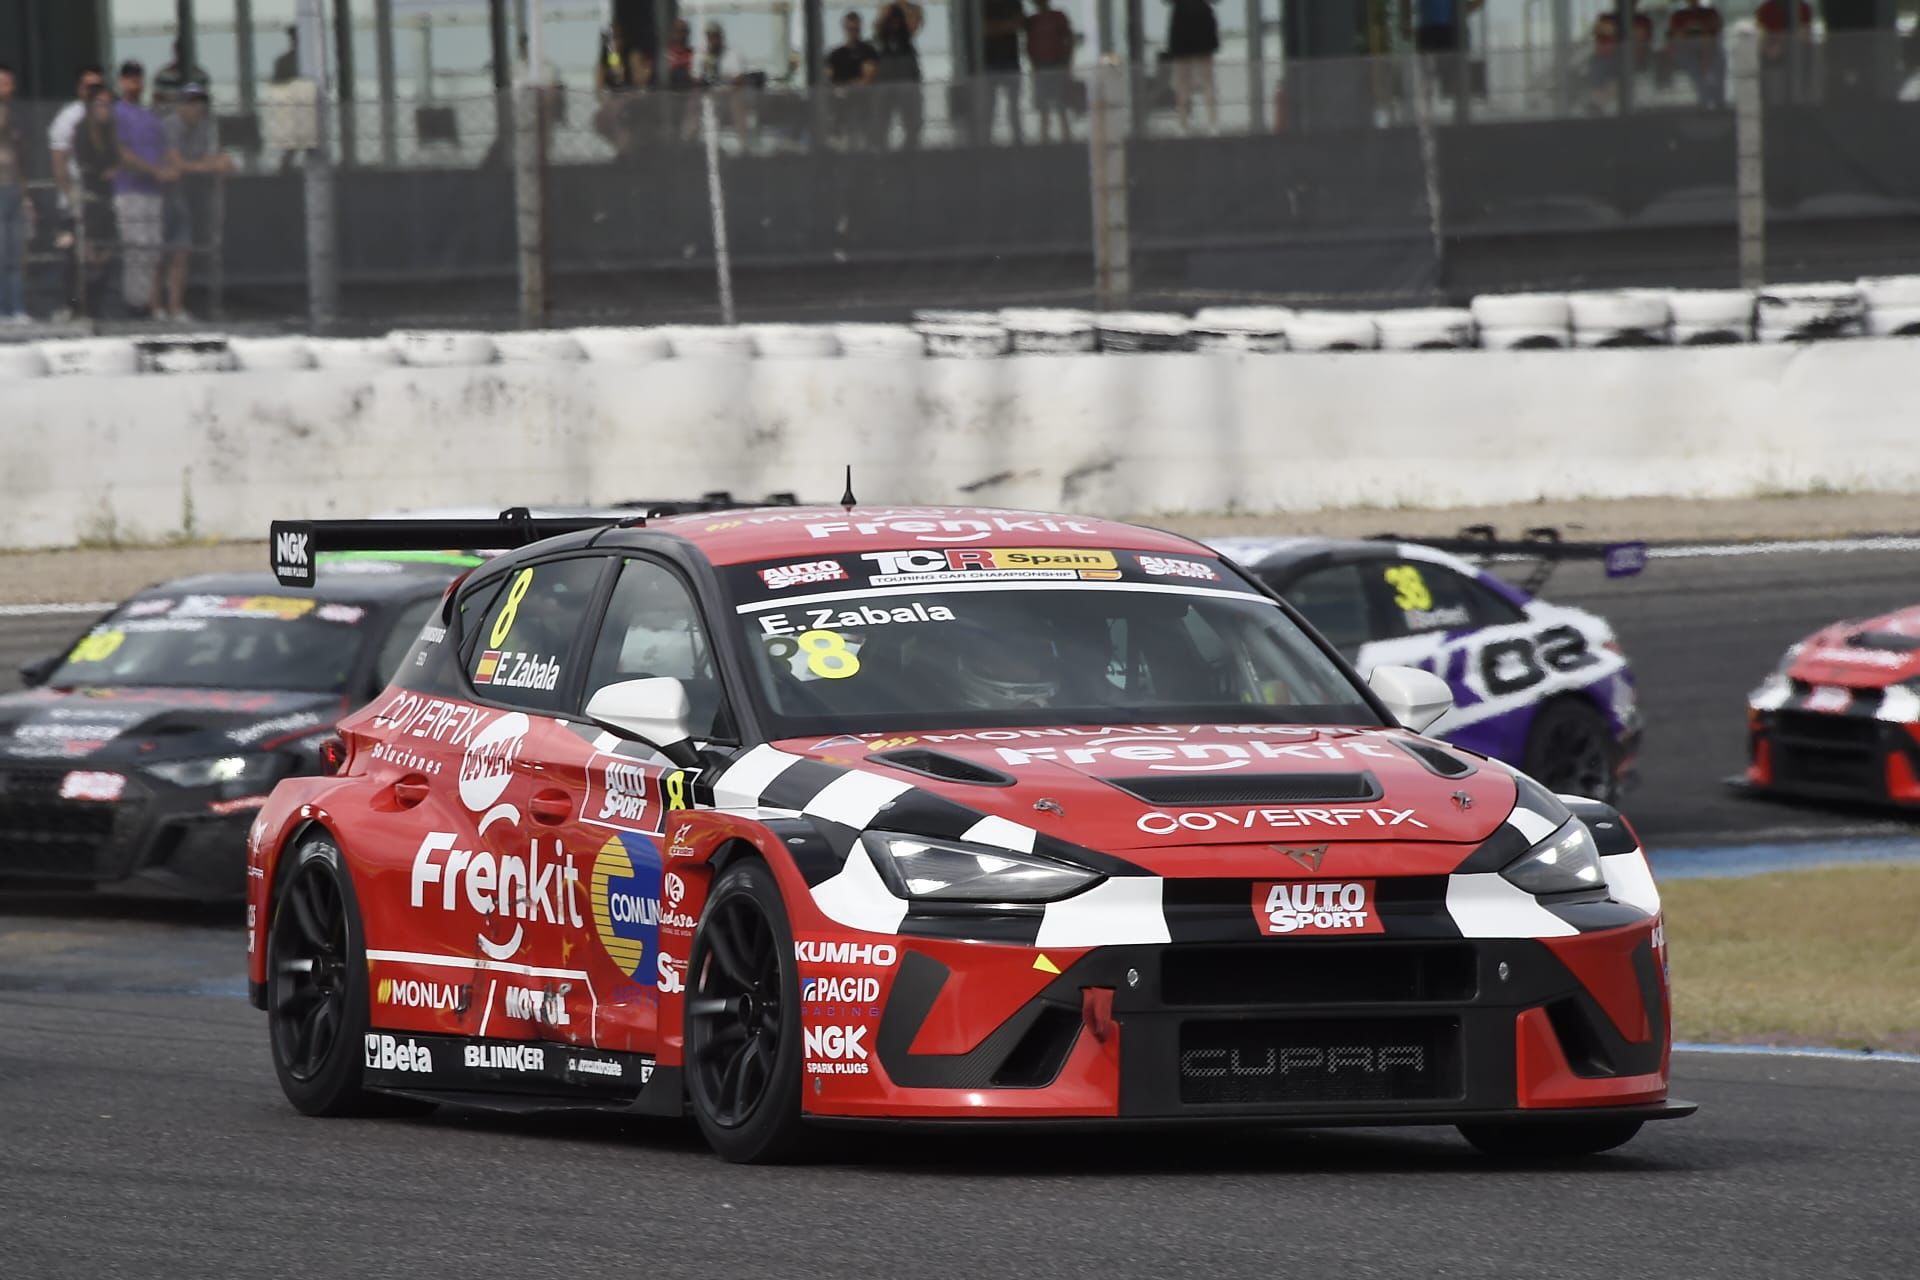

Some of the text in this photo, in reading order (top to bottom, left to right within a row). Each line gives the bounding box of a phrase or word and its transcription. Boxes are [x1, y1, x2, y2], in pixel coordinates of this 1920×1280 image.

[804, 517, 1097, 538] Frenkit
[276, 531, 309, 565] NGK
[861, 549, 1102, 574] TCR Spain
[763, 560, 841, 581] AUTO
[767, 569, 843, 590] SPORT
[876, 574, 936, 583] TOURING
[975, 571, 1073, 579] CHAMPIONSHIP
[489, 567, 534, 649] 8
[797, 629, 861, 679] 8
[372, 690, 490, 748] COVERFIX
[921, 726, 1180, 743] MONLAU
[995, 740, 1395, 766] Frenkit
[605, 762, 646, 798] AUTO
[666, 770, 687, 811] 8
[598, 788, 648, 821] SPORT
[1136, 808, 1429, 835] COVERFIX
[411, 831, 584, 929] Frenkit
[1264, 883, 1365, 913] AUTO
[1268, 909, 1368, 933] SPORT
[794, 941, 897, 966] KUMHO
[817, 977, 880, 1002] PAGID
[381, 1035, 433, 1073] Beta
[803, 1025, 869, 1060] NGK
[464, 1045, 545, 1072] BLINKER
[807, 1063, 869, 1074] SPARK PLUGS
[1182, 1046, 1424, 1077] CUPRA
